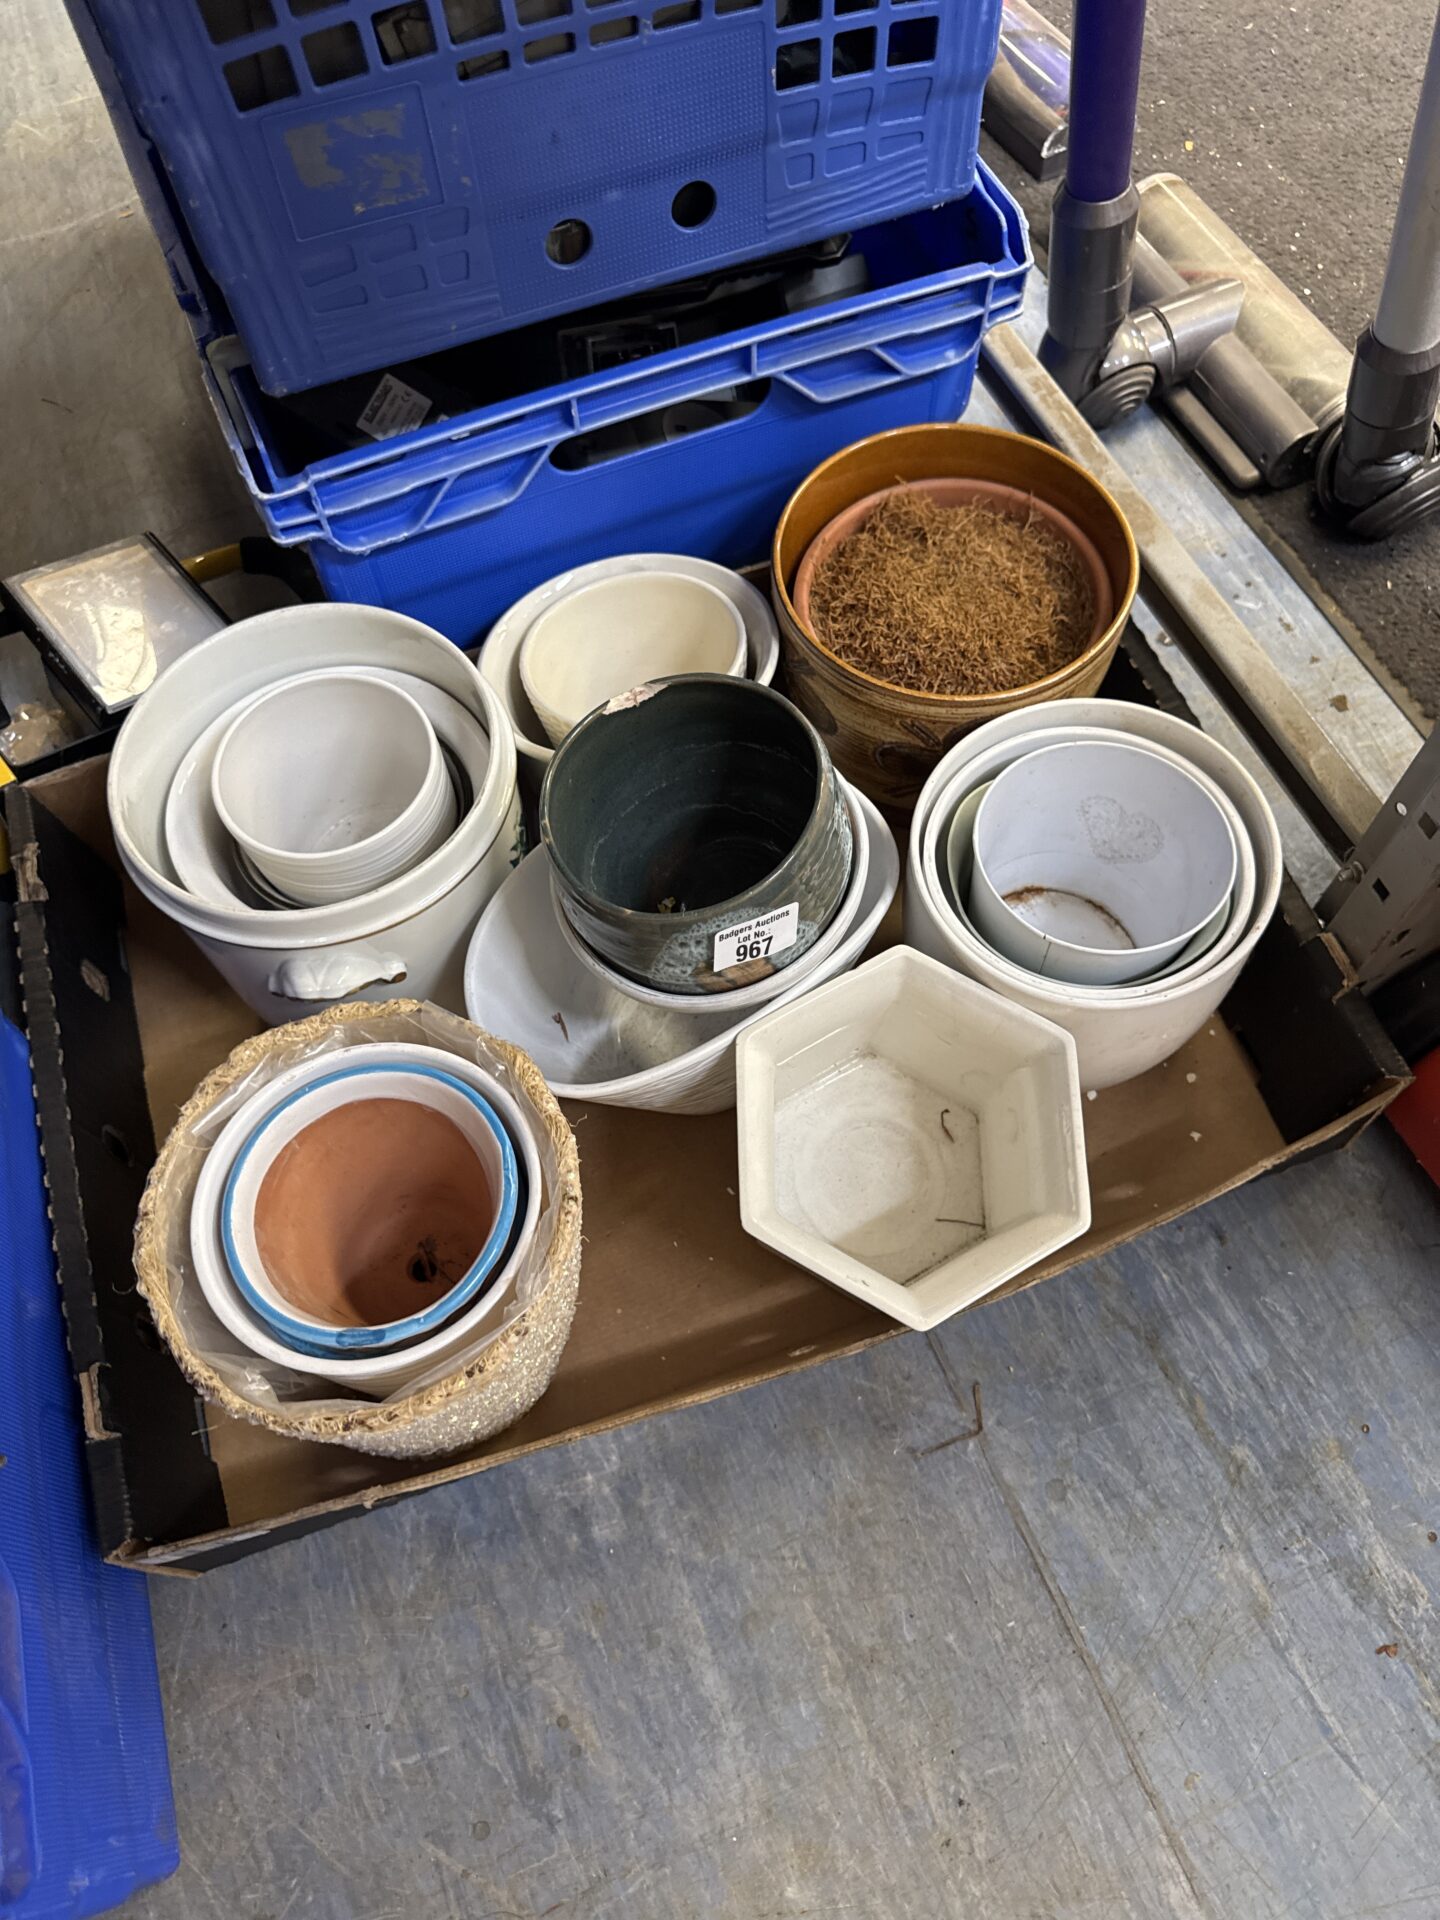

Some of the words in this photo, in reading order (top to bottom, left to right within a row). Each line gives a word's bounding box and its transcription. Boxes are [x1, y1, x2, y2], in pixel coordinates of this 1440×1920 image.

[719, 925, 752, 942] Badgers
[755, 910, 790, 928] Auctions
[737, 934, 751, 944] Lot
[736, 935, 773, 962] 967
